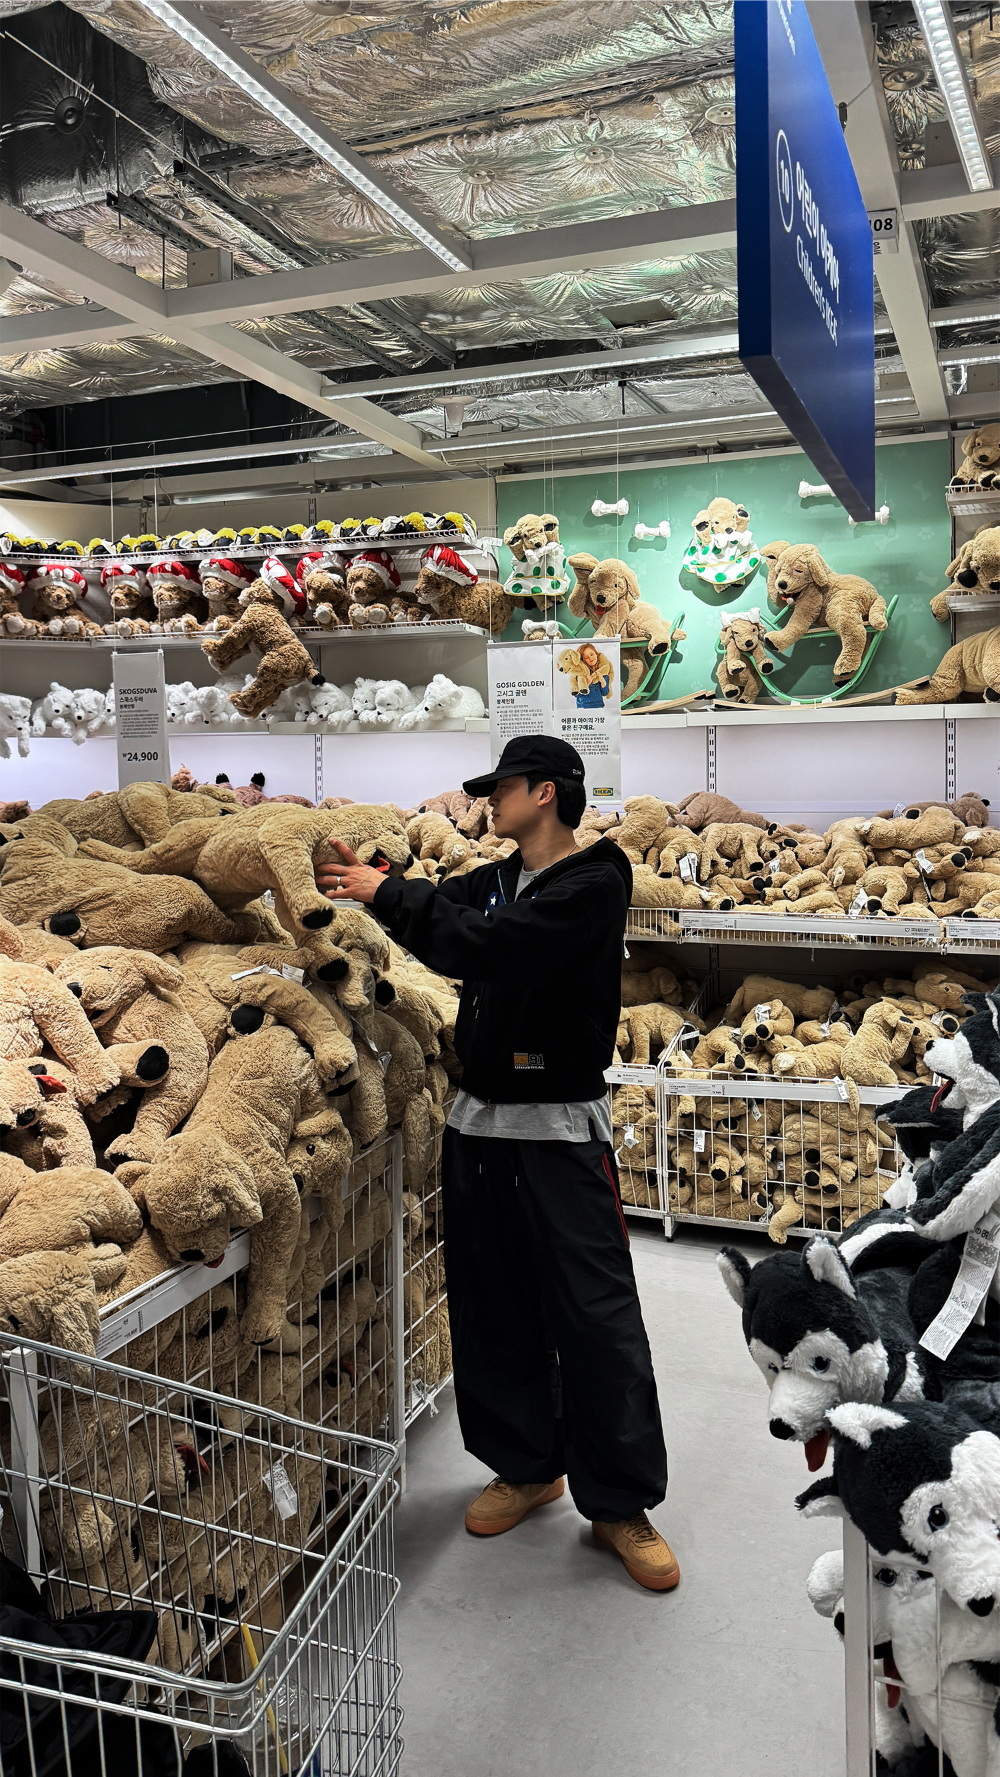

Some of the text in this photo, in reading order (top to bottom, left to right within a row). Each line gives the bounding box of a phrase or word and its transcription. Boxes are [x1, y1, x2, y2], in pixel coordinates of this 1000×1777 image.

[780, 160, 790, 203] 10
[796, 161, 820, 256] 어린이
[825, 298, 838, 346] IKEA
